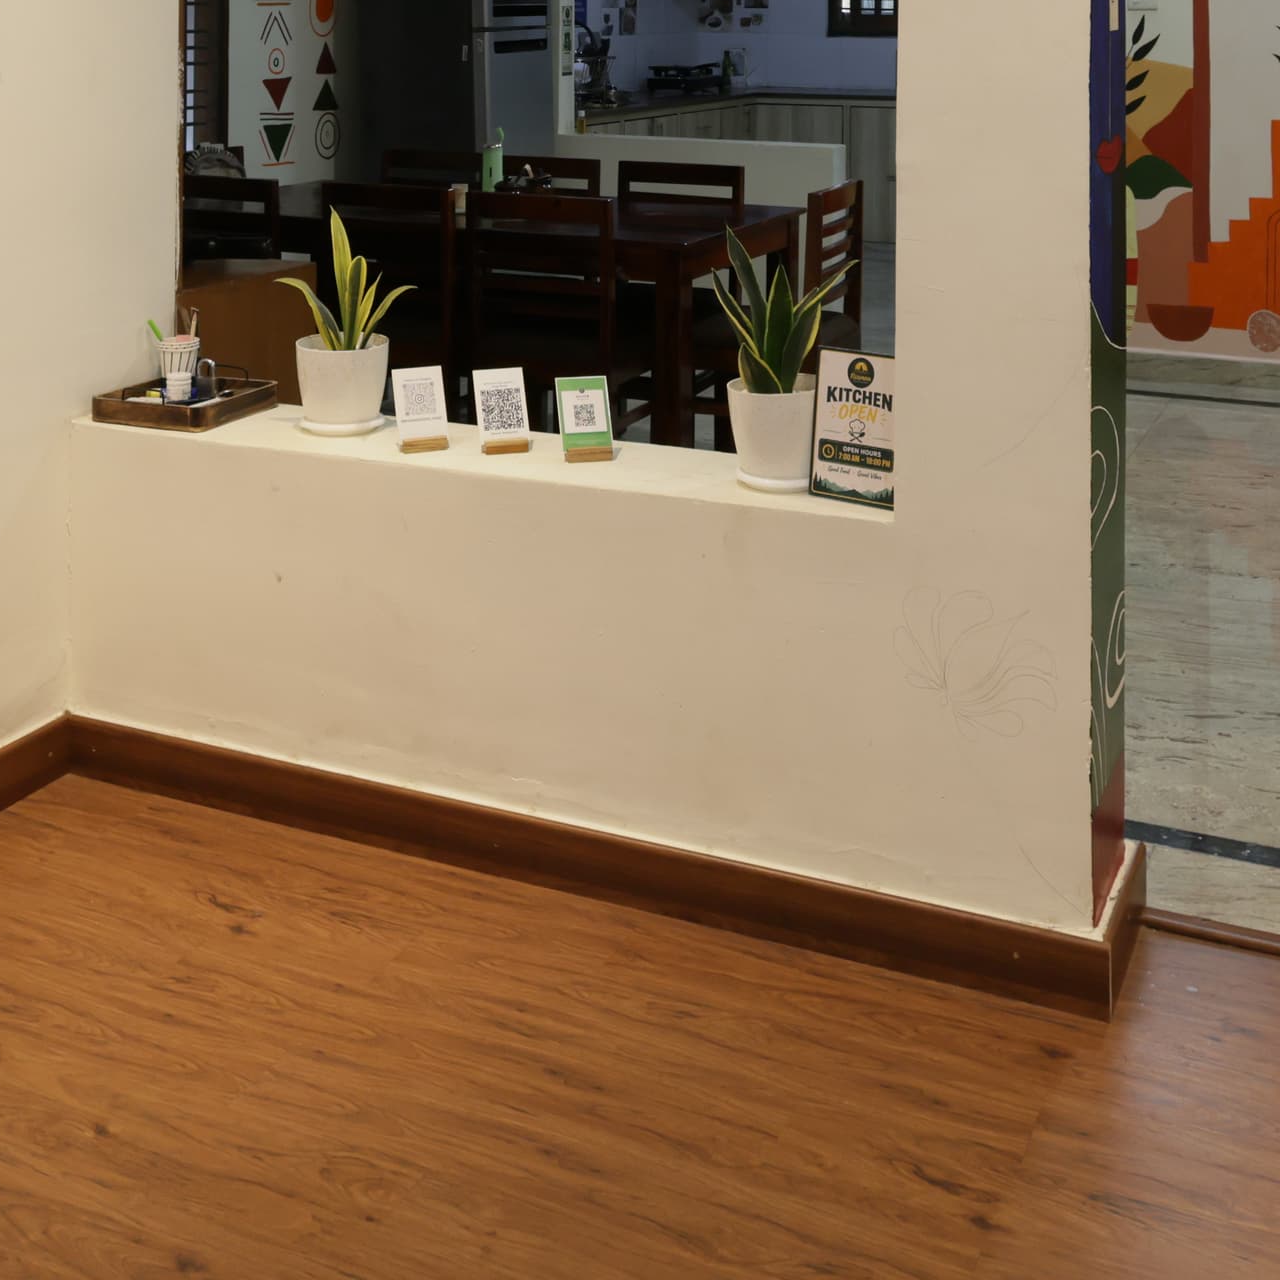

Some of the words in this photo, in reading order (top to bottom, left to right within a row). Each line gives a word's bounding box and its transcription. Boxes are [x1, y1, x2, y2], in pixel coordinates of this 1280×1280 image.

[826, 386, 894, 413] KITCHEN
[838, 403, 879, 424] OPEN
[842, 446, 859, 455] OPEN
[860, 448, 882, 458] HOURS
